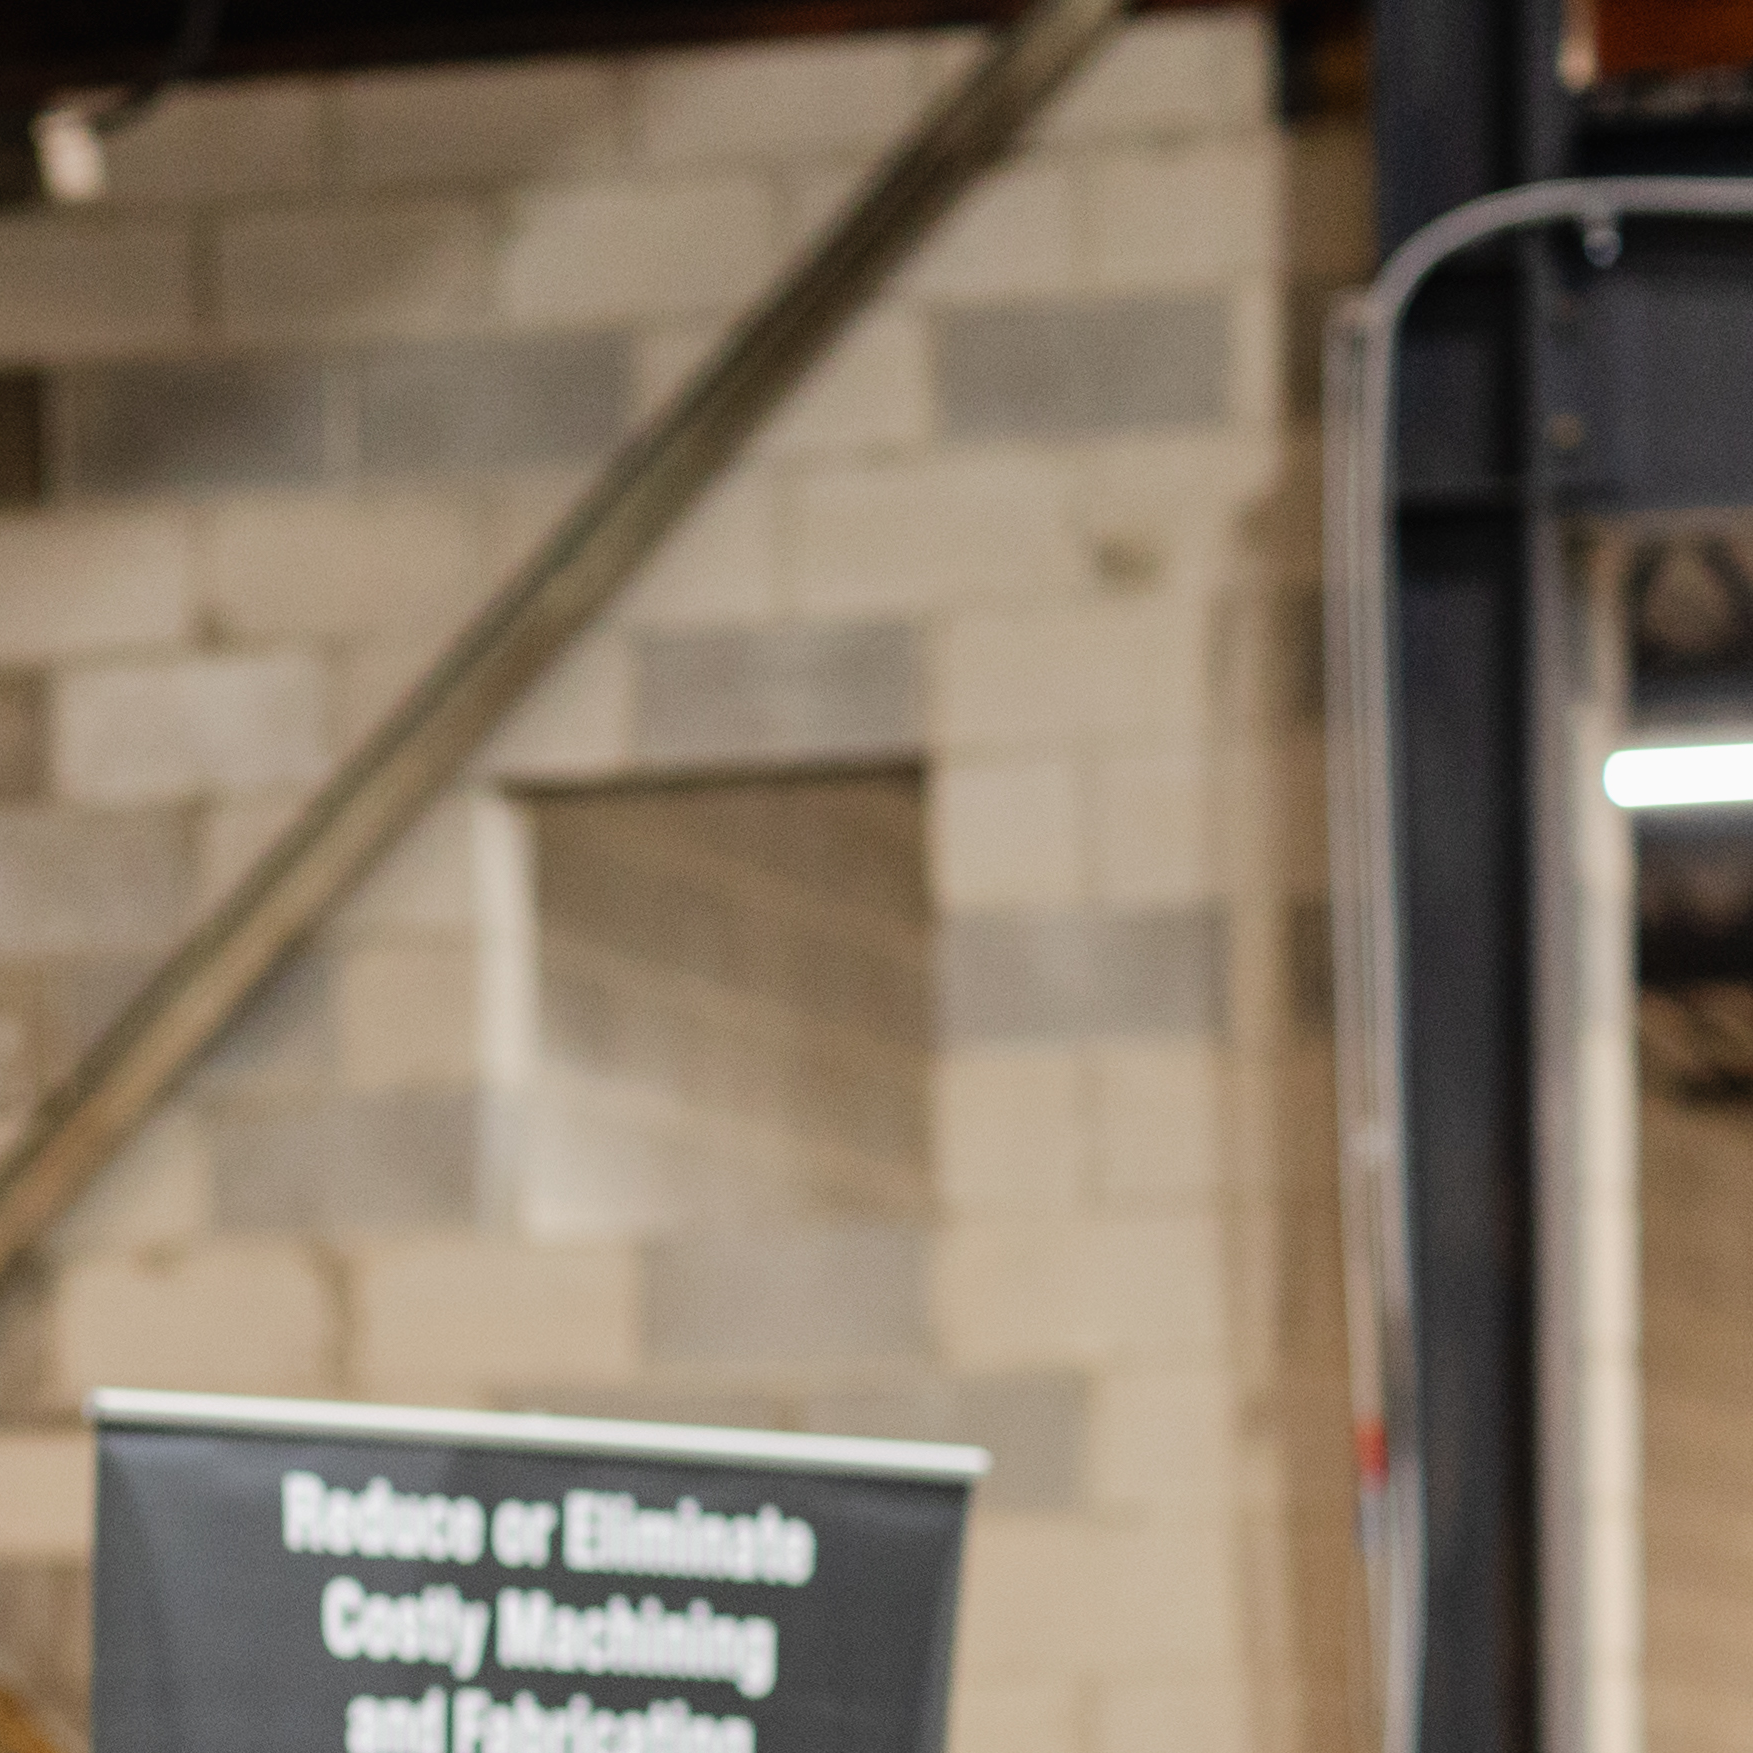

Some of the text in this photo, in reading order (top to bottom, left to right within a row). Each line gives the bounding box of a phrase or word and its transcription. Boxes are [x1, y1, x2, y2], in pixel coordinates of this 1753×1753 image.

[281, 1470, 816, 1586] Reduce or Eliminate
[321, 1576, 777, 1698] Costly Machining
